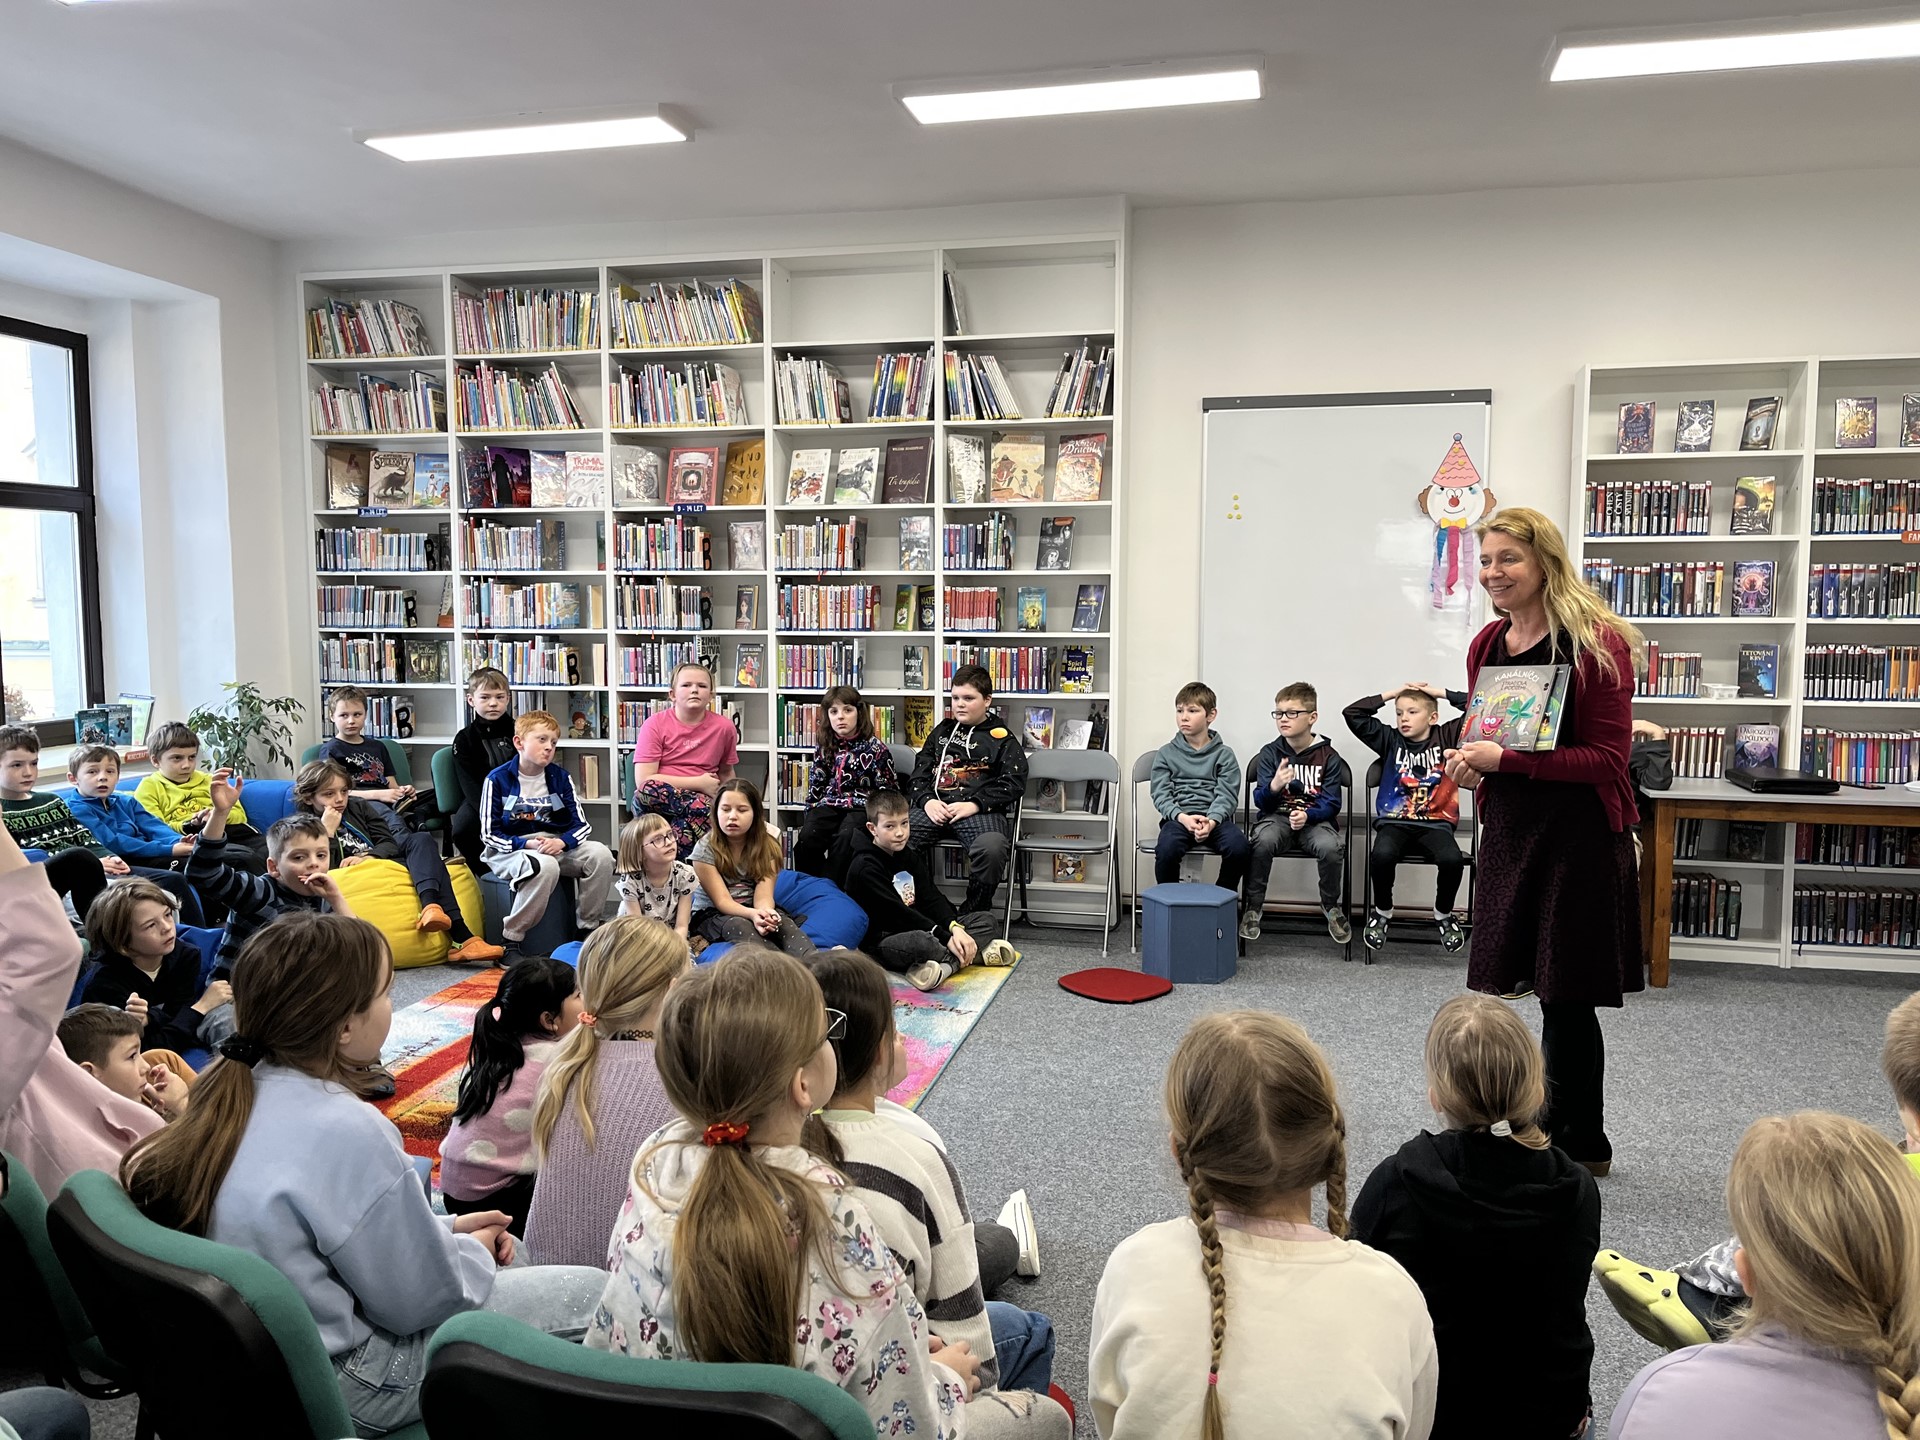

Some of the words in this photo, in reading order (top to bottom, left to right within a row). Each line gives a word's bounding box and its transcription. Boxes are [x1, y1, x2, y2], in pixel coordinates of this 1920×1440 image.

[701, 645, 720, 655] BITVA
[1494, 669, 1540, 683] KANÁLNÍČCI
[1395, 746, 1441, 771] LAMINE
[1287, 763, 1322, 787] MINE
